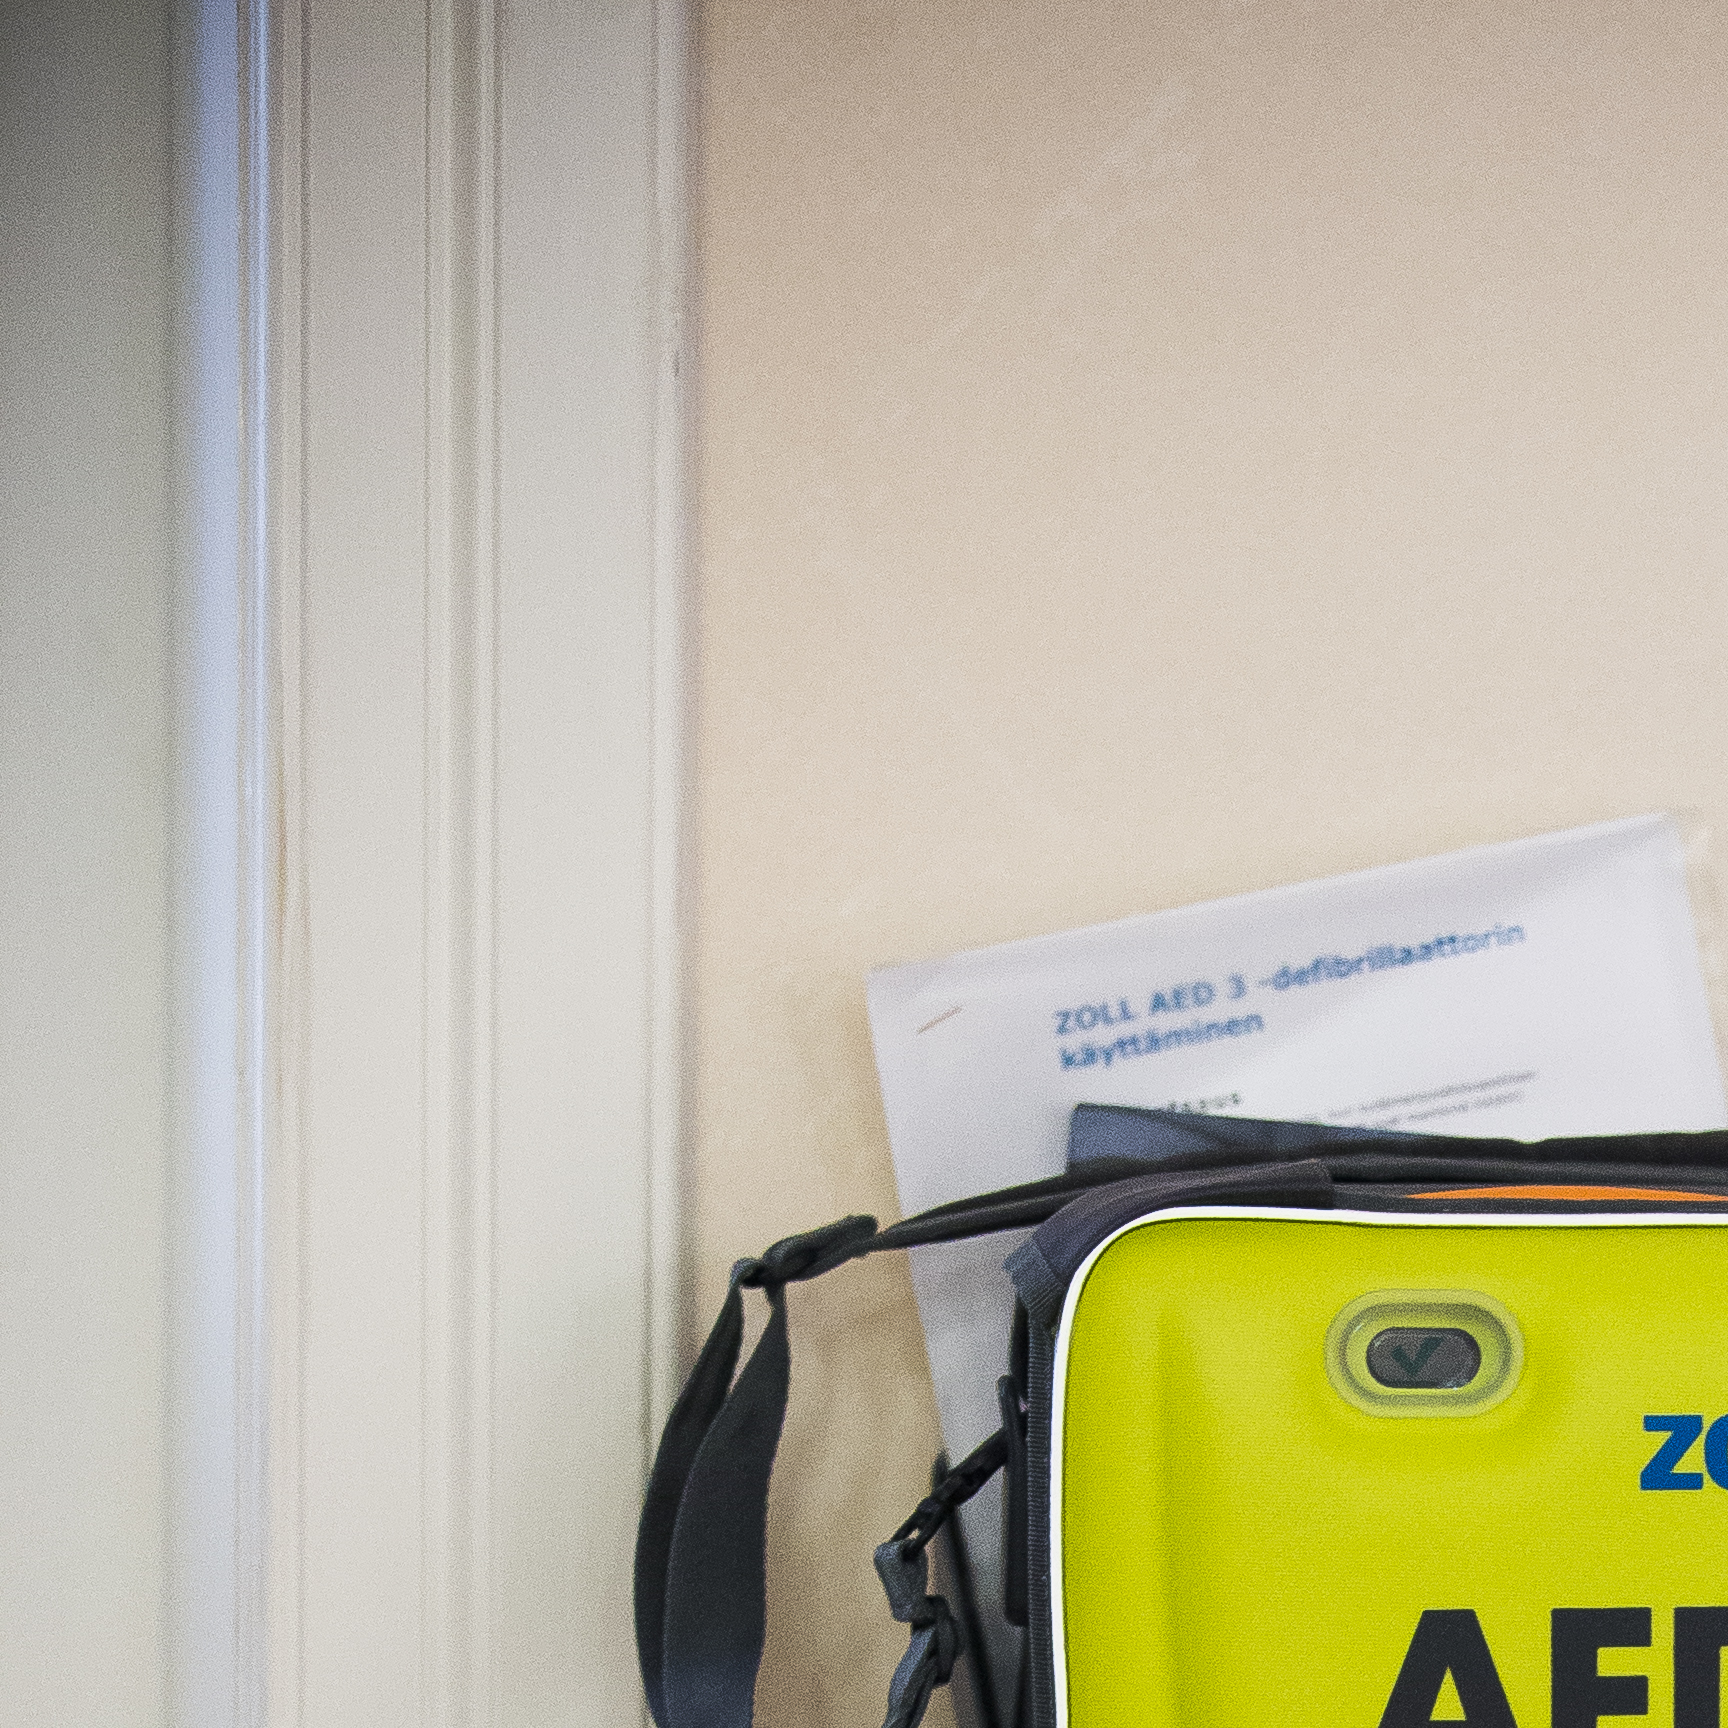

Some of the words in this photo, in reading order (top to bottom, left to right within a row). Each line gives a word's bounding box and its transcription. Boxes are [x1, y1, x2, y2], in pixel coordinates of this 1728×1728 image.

[1056, 998, 1135, 1035] ZOLL
[1150, 980, 1216, 1016] AED
[1060, 1013, 1264, 1071] käyttäminen
